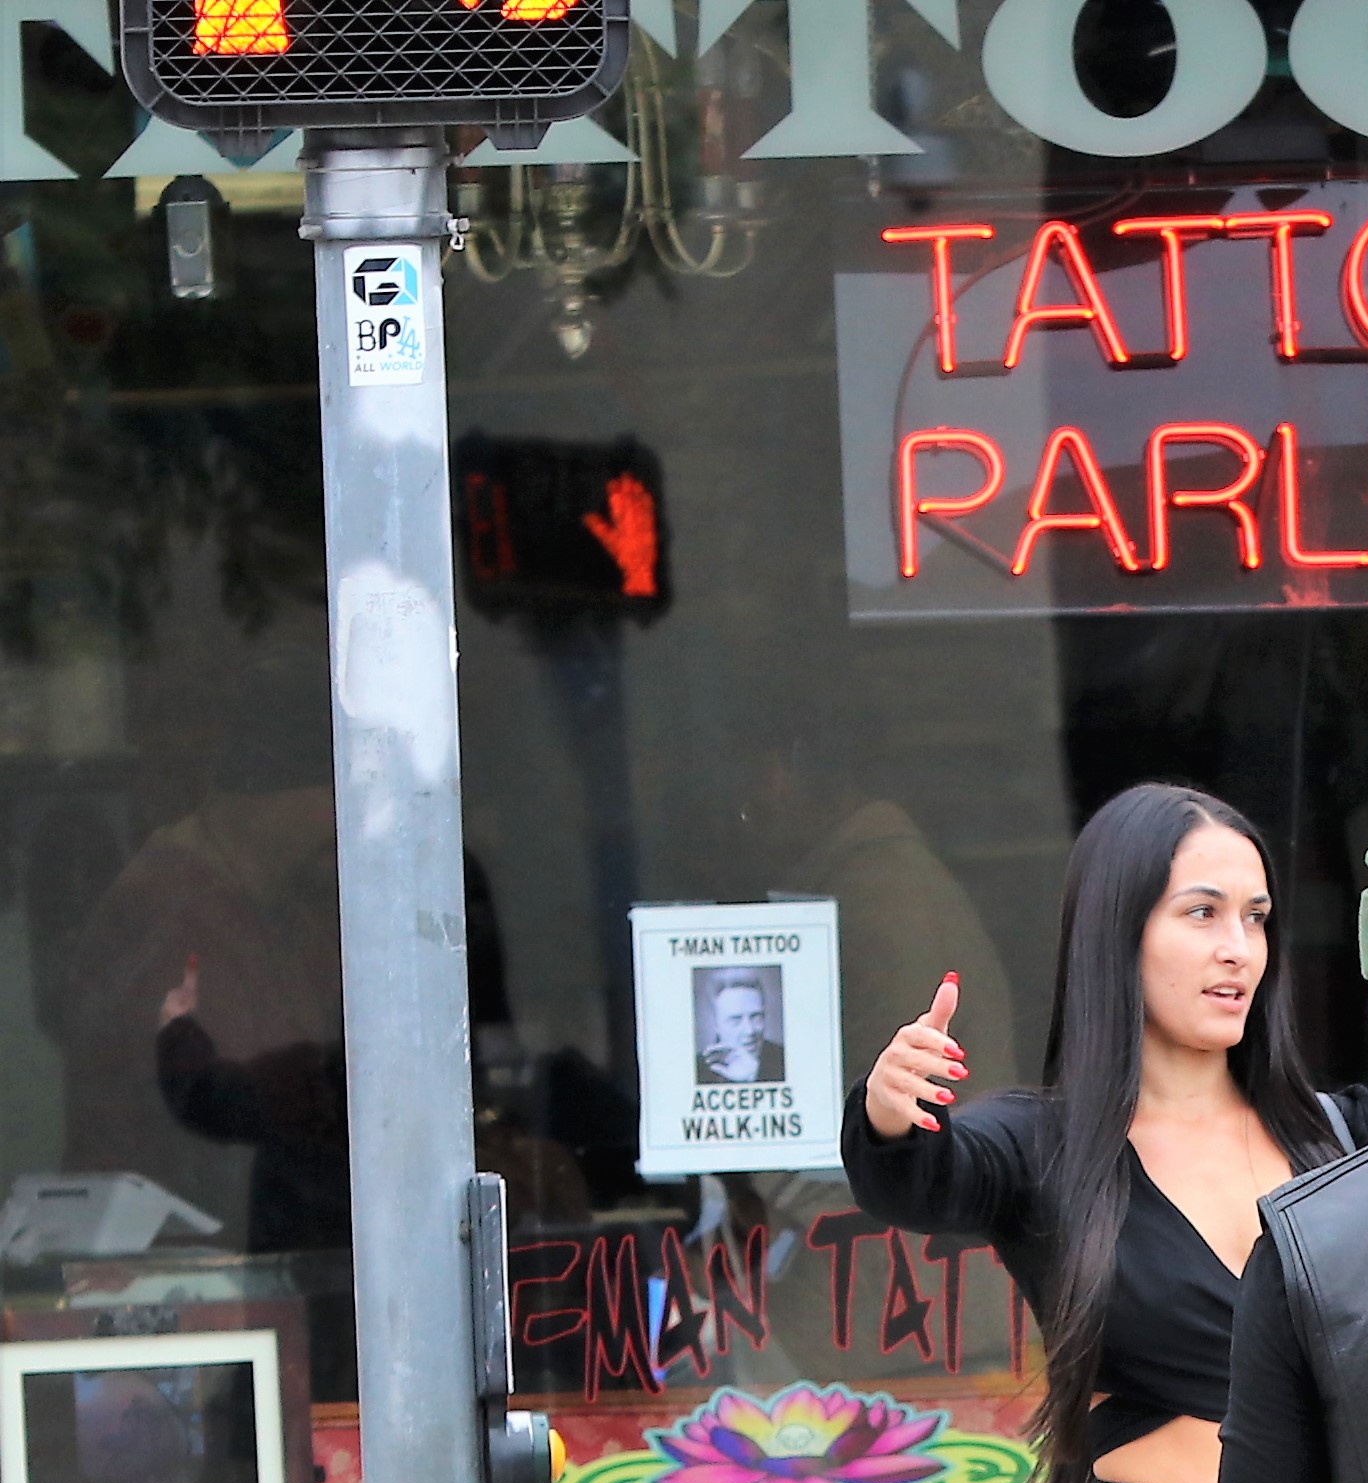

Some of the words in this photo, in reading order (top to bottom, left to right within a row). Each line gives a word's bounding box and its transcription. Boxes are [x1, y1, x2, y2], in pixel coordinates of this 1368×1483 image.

[354, 363, 375, 373] ALL
[380, 361, 423, 371] WORLD
[668, 937, 725, 958] T-MAN
[730, 934, 801, 955] TATTOO
[692, 1086, 794, 1112] ACCEPTS
[681, 1113, 802, 1141] WALK-INS
